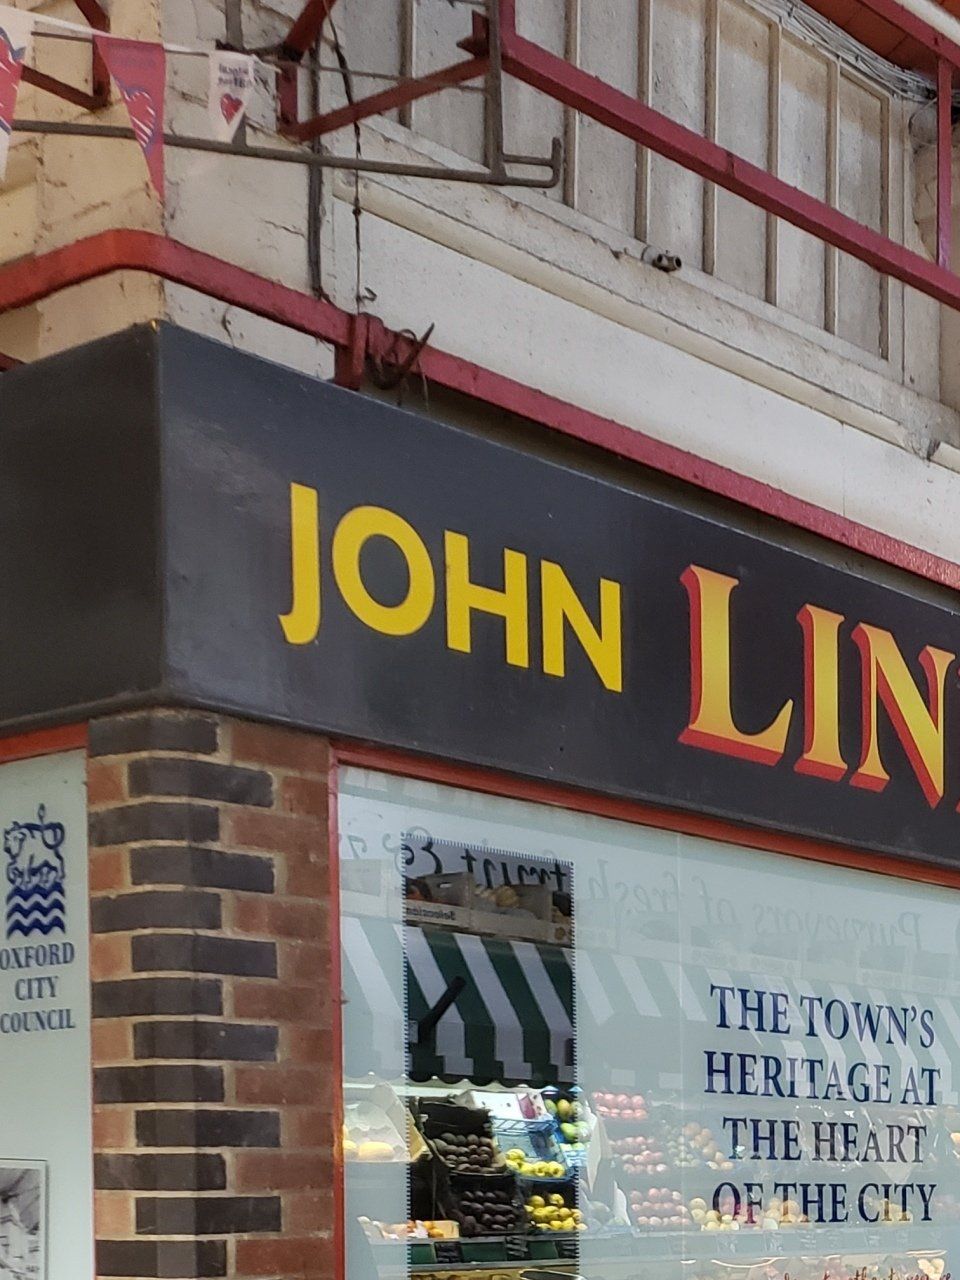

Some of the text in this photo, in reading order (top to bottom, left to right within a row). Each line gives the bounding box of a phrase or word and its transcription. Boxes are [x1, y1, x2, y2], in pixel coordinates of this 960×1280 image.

[278, 482, 623, 693] JOHN
[0, 941, 75, 971] OXFORD
[14, 975, 59, 1001] CITY
[710, 983, 792, 1035] THE
[0, 1008, 76, 1034] COUNCIL
[703, 1050, 941, 1106] HERITAGE AT
[722, 1116, 927, 1164] THE HEART
[712, 1181, 938, 1224] OF THE CITY
